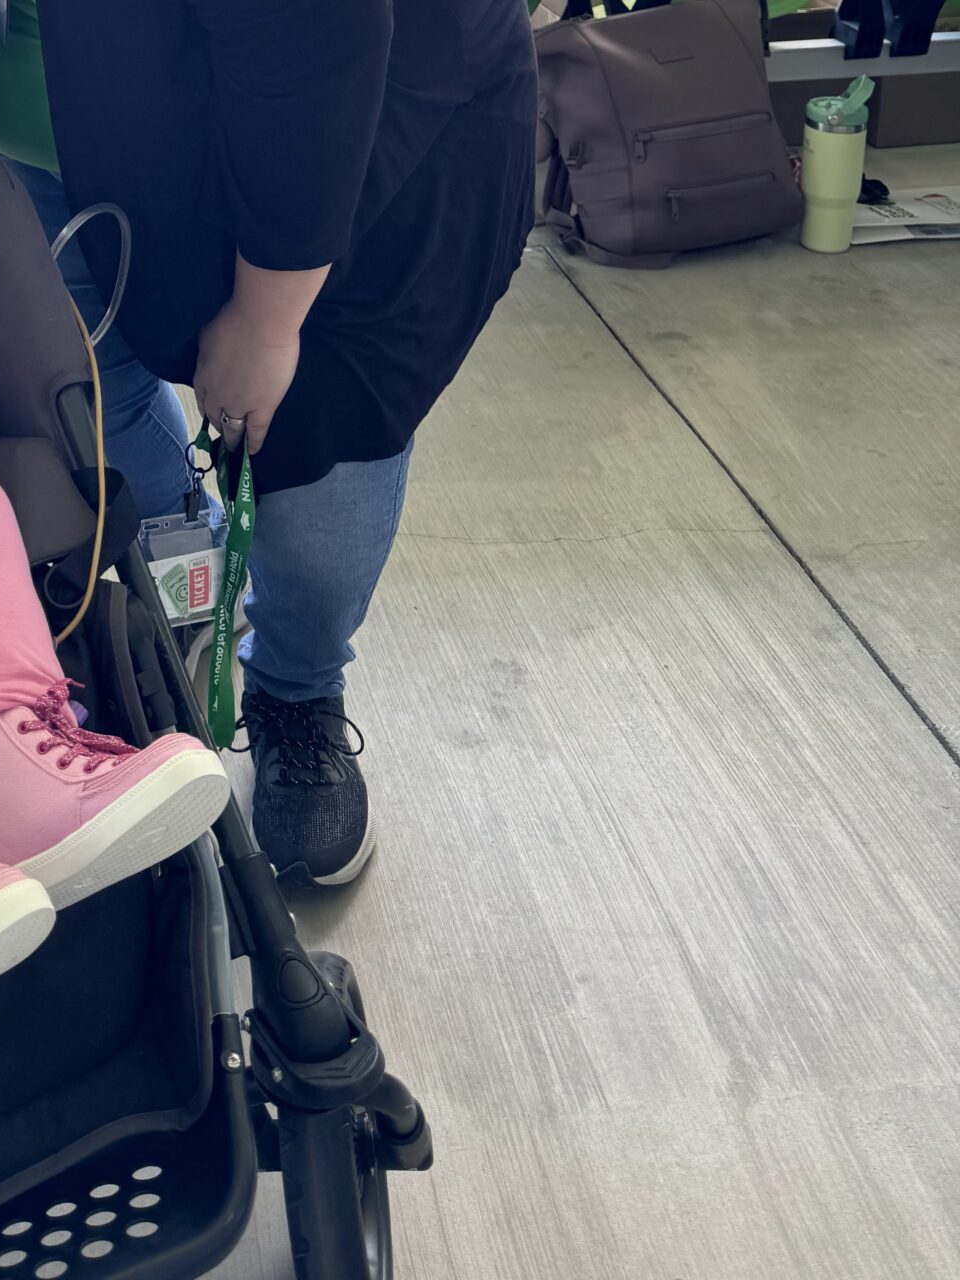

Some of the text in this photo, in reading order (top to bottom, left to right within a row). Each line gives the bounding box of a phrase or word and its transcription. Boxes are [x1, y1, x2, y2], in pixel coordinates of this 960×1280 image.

[242, 472, 251, 502] NICU
[229, 551, 239, 573] Hold
[193, 569, 206, 607] TICKET
